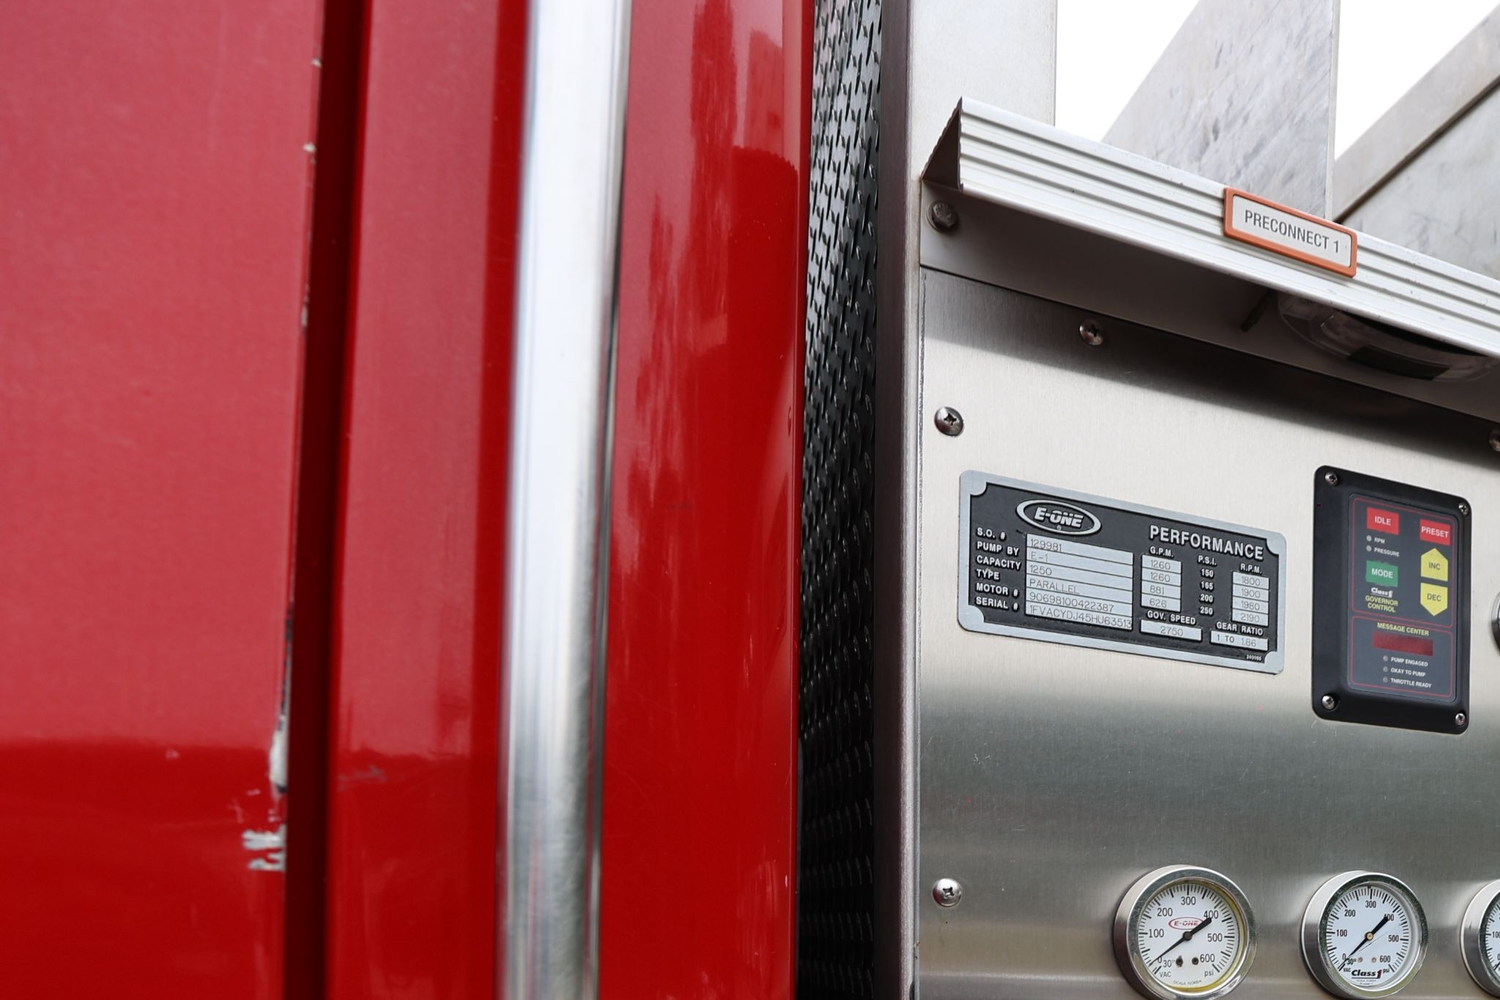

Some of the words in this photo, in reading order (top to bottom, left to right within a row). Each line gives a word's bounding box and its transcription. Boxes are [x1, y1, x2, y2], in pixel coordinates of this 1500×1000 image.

[1245, 209, 1330, 250] PRECONNECT
[1334, 240, 1339, 253] 1
[1034, 507, 1084, 528] E-ONE
[1375, 516, 1392, 526] IDLE
[977, 527, 996, 539] S.O.
[1421, 526, 1449, 539] PRESET
[1150, 525, 1263, 560] PERFORMANCE
[977, 541, 1002, 553] PUMP
[1007, 546, 1019, 556] BY
[1150, 546, 1174, 558] G.P.M.
[1374, 547, 1400, 558] PRESSURE
[977, 555, 1021, 571] CAPACITY
[1030, 552, 1048, 563] E-1
[1198, 555, 1217, 566] P.S.I.
[1150, 559, 1171, 570] 1260
[1241, 563, 1262, 574] R.P.M.
[1429, 562, 1441, 571] INC
[976, 569, 1000, 581] TYPE
[1030, 565, 1052, 576] 1250
[1201, 569, 1214, 578] 150
[1371, 568, 1394, 579] MODE
[1150, 571, 1171, 583] 1260
[976, 583, 1009, 596] MOTOR
[1030, 579, 1080, 595] PARALLEL
[1150, 584, 1165, 595] 881
[1201, 594, 1213, 603] 200
[1365, 595, 1399, 607] GOVERNOR
[1427, 593, 1442, 602] DEC
[976, 597, 1008, 610] SERIAL
[1368, 602, 1396, 613] CONTROL
[1200, 607, 1213, 616] 250
[1148, 610, 1166, 620] GOV.
[1171, 614, 1196, 625] SPEED
[1161, 626, 1184, 637] 2750
[1217, 621, 1237, 632] GEAR
[1242, 625, 1263, 636] RATIO
[1377, 622, 1406, 633] MESSAGE
[1407, 627, 1430, 637] CENTER
[1225, 635, 1235, 644] TO
[1405, 659, 1429, 667] ENGAGED
[1391, 678, 1415, 687] THROTTLE
[1181, 896, 1197, 906] 300
[1157, 908, 1173, 917] 200
[1204, 910, 1219, 920] 400
[1345, 909, 1356, 917] 200
[1149, 929, 1165, 938] 100
[1208, 933, 1223, 942] 500
[1337, 929, 1348, 937] 100
[1200, 954, 1215, 963] 600
[1380, 955, 1391, 963] 600
